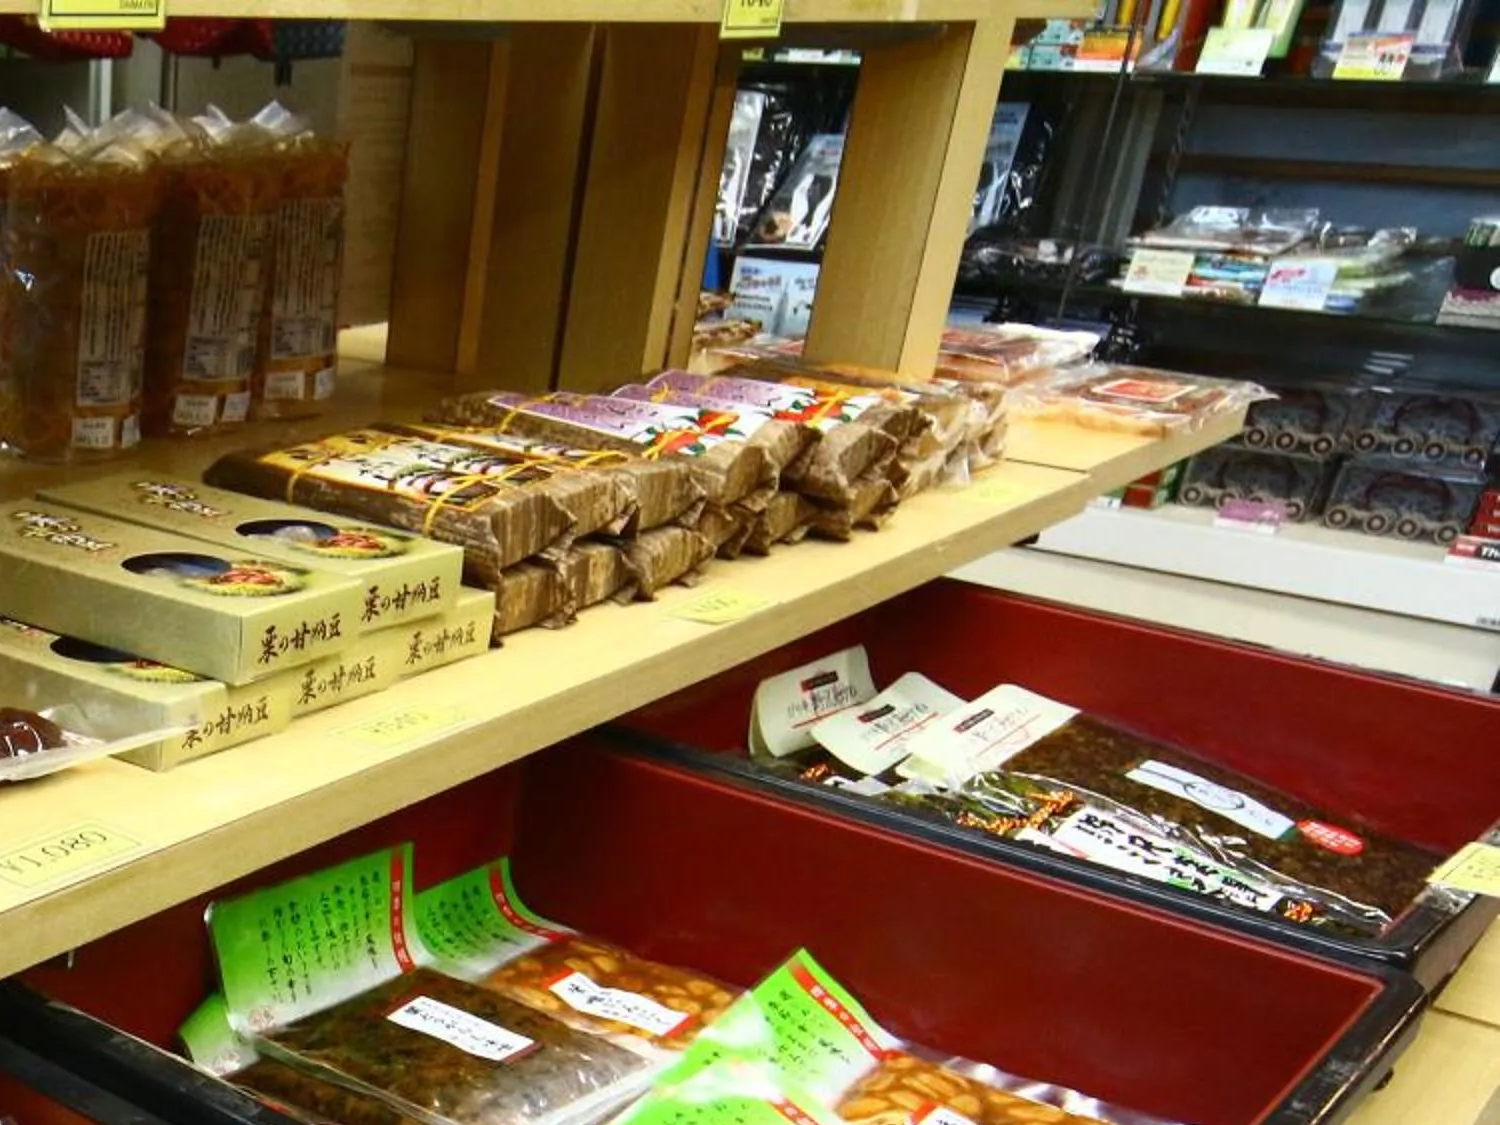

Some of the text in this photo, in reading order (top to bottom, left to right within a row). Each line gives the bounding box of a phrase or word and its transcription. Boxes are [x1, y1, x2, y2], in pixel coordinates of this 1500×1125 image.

[361, 577, 441, 623] 栗の甘納豆
[257, 613, 342, 666] 栗の甘納豆
[405, 622, 477, 666] 栗の甘納豆
[297, 656, 377, 706] 栗の甘納豆
